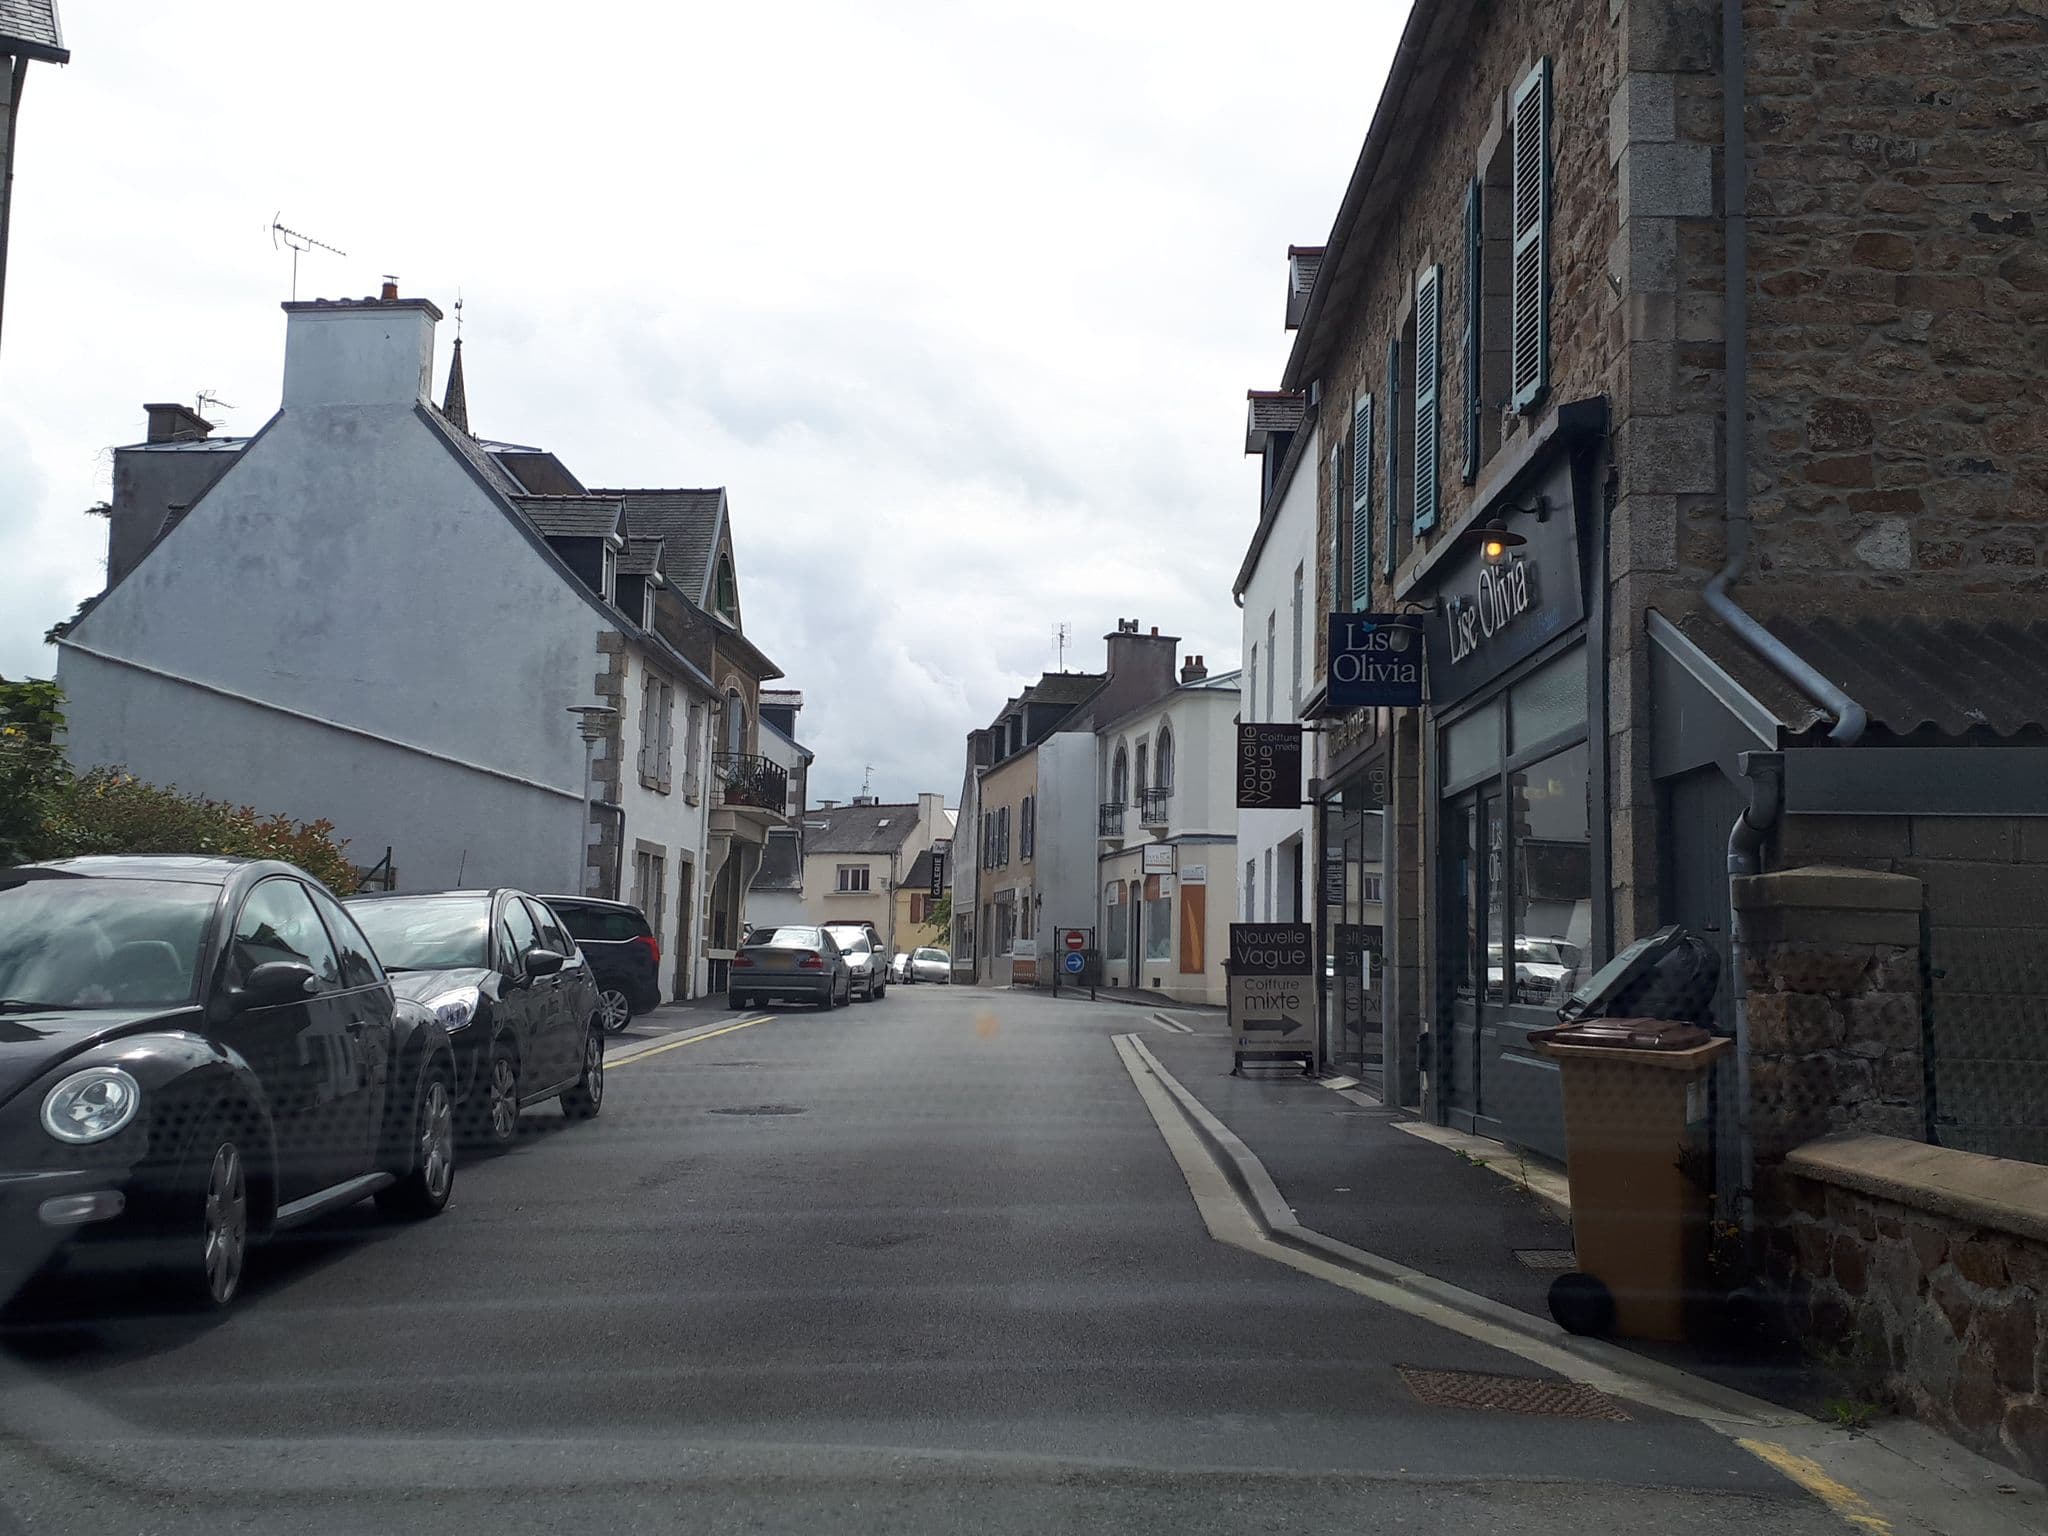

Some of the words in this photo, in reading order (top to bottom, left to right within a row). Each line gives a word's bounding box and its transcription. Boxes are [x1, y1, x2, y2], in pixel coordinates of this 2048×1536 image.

[1446, 600, 1478, 664] Lise
[1479, 553, 1530, 638] Olivia
[1345, 622, 1396, 651] Lis
[1333, 653, 1417, 682] Olivia
[1259, 733, 1299, 742] Coiffure
[1240, 726, 1257, 802] Nouvelle
[1256, 745, 1276, 804] Vague
[933, 857, 942, 896] GALERIE
[1236, 930, 1305, 944] Nouvelle
[1237, 946, 1306, 969] Vague
[1244, 979, 1300, 990] Coiffure
[1244, 992, 1300, 1010] mixte
